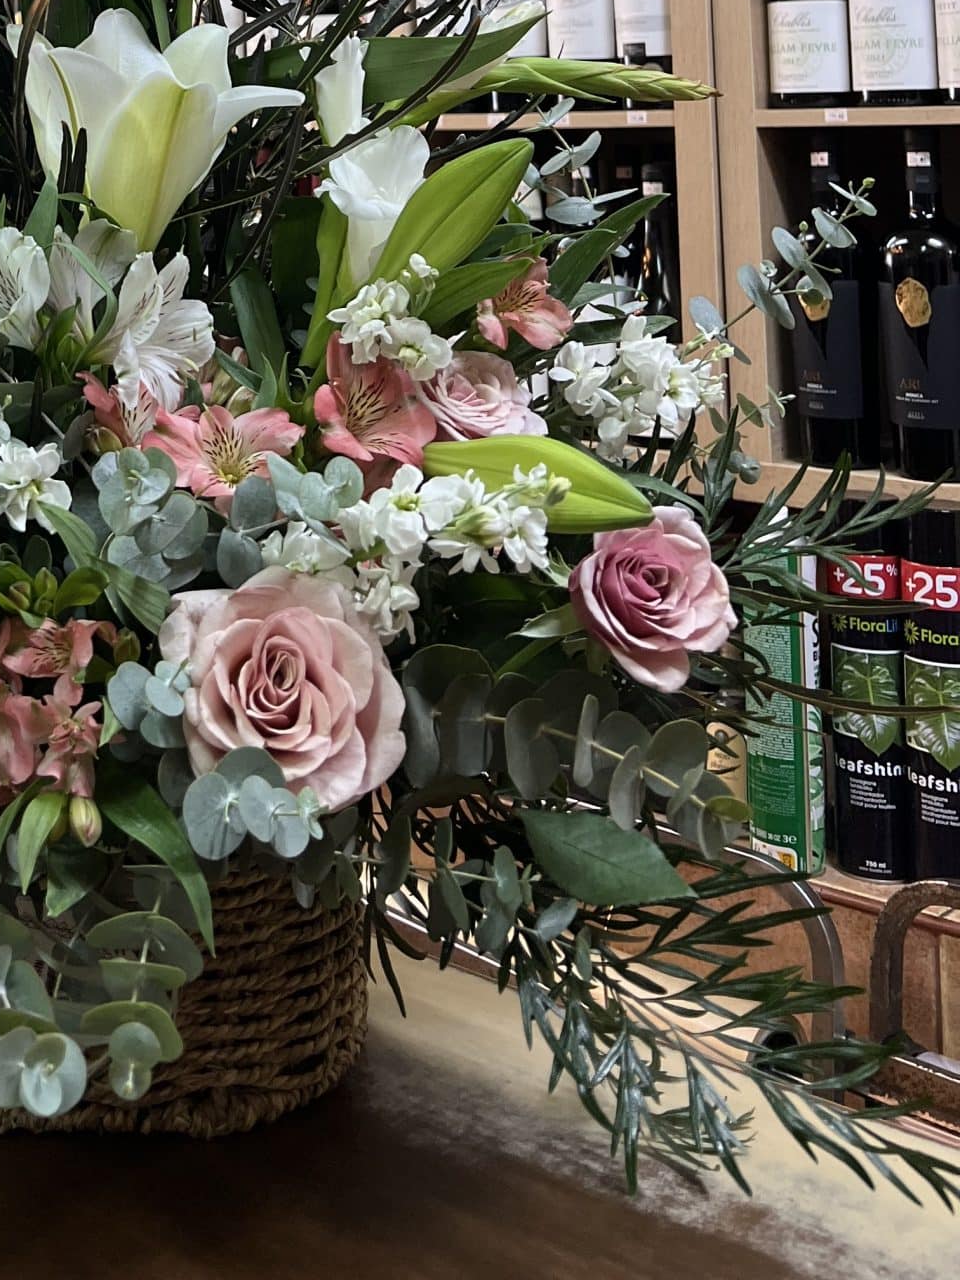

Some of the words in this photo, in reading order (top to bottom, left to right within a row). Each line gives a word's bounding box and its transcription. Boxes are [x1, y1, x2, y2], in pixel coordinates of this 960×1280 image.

[905, 571, 959, 609] +25
[835, 752, 904, 777] leafshin
[907, 766, 960, 793] leafsh
